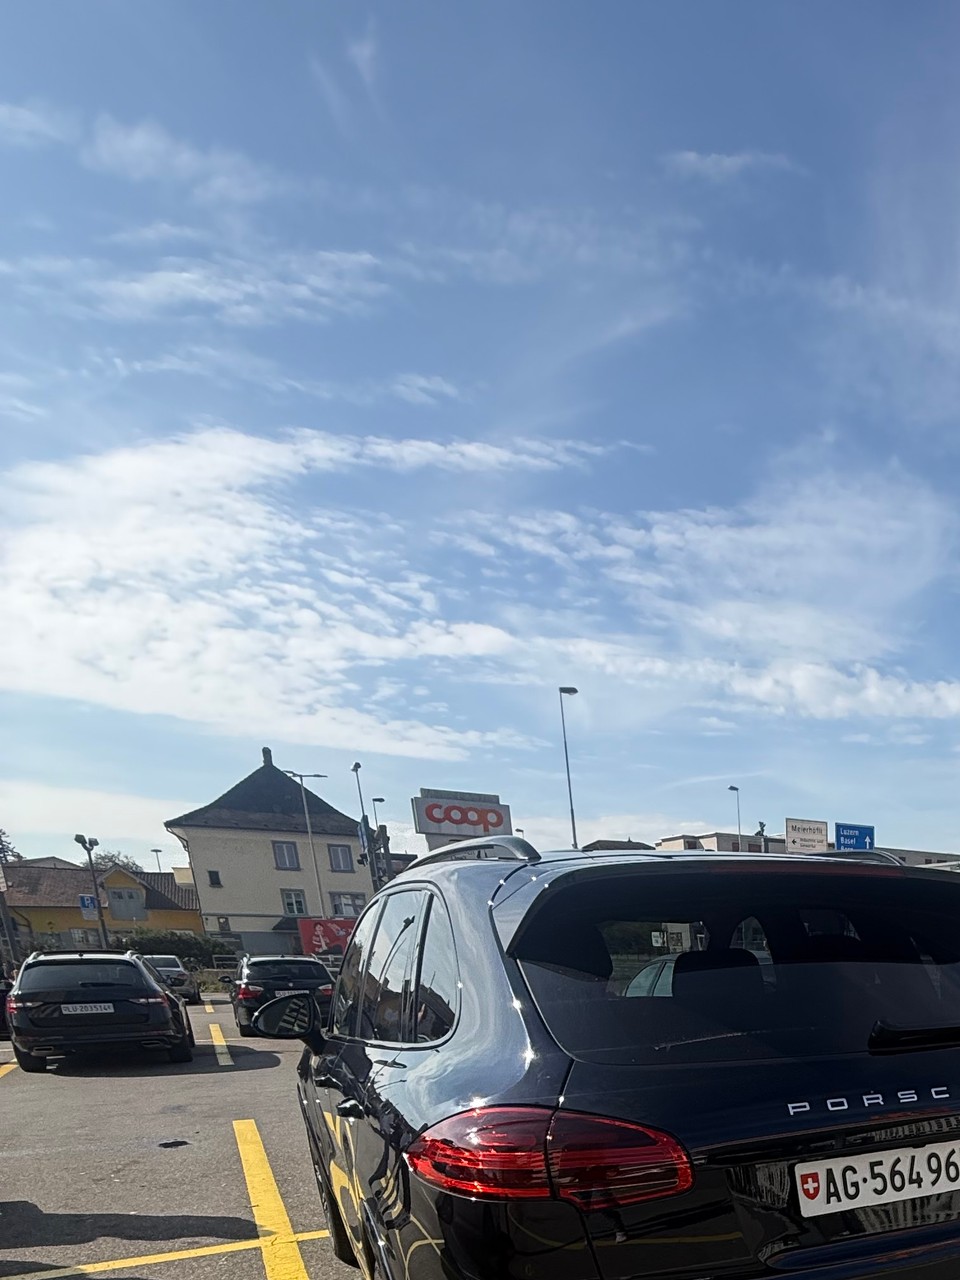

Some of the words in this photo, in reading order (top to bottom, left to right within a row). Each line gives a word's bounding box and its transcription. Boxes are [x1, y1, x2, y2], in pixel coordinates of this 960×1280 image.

[425, 803, 504, 833] coop
[840, 827, 860, 836] Luzern
[840, 836, 856, 845] Basel
